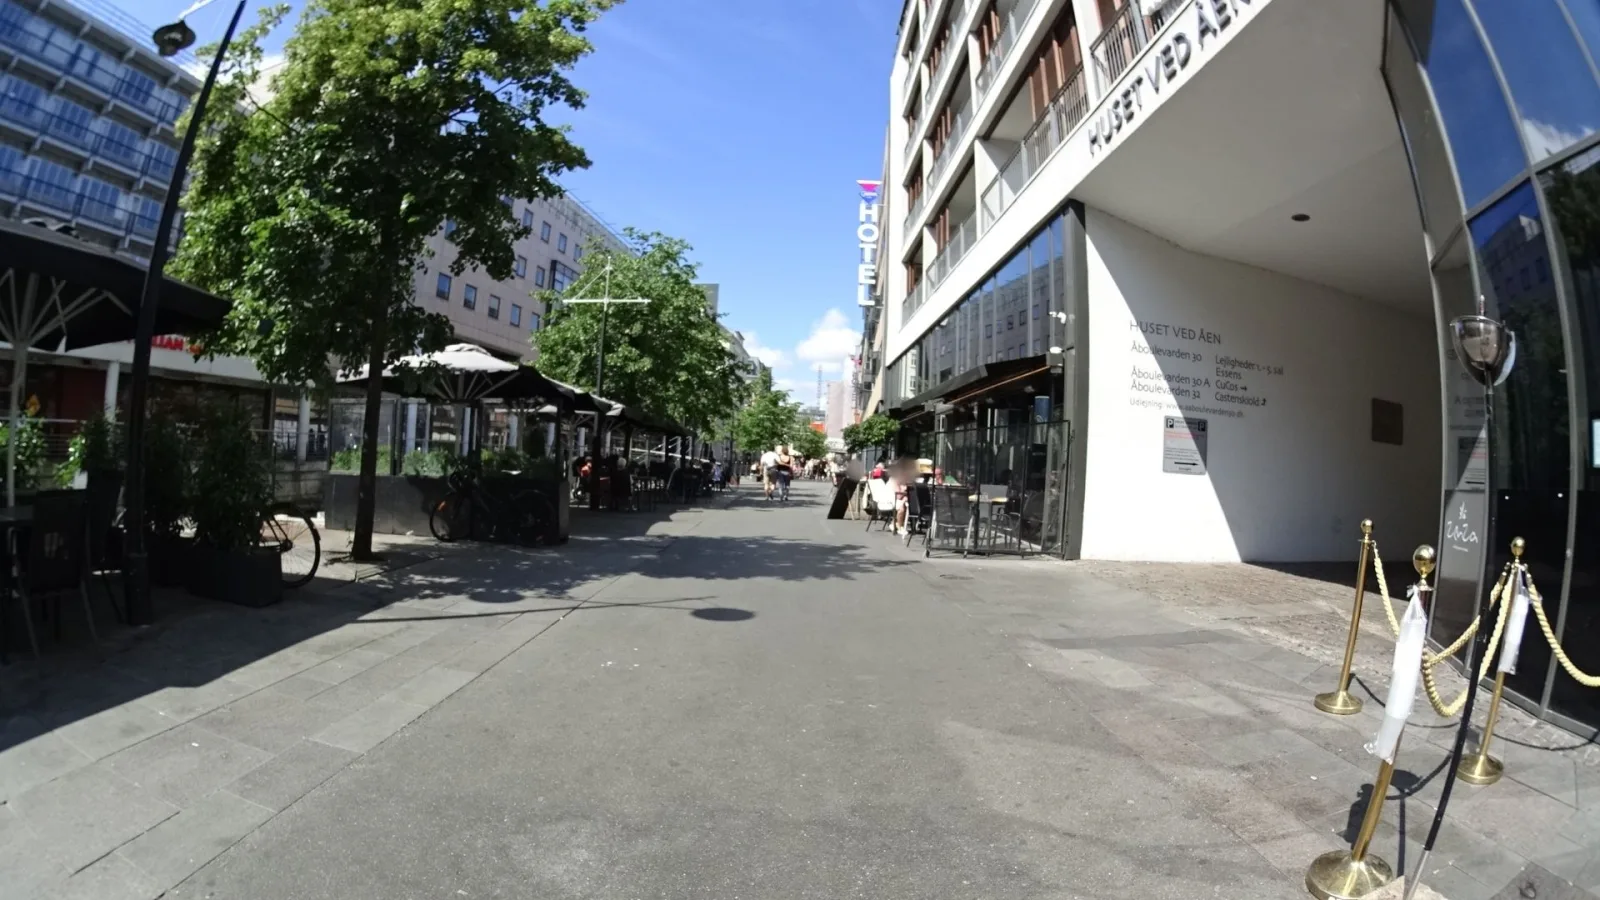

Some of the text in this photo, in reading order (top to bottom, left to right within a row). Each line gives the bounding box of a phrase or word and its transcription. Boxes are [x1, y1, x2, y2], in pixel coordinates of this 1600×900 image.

[1088, 75, 1143, 158] HUSET
[1145, 32, 1192, 94] VED
[857, 202, 879, 306] HOTEL
[1130, 319, 1222, 345] HUSET VED ÅEN
[1130, 340, 1203, 363] Åboulevarden 30
[1191, 377, 1203, 388] 30
[1203, 377, 1211, 388] A
[1216, 367, 1242, 380] Essens
[1215, 379, 1239, 392] CuCos
[1191, 390, 1201, 400] 32
